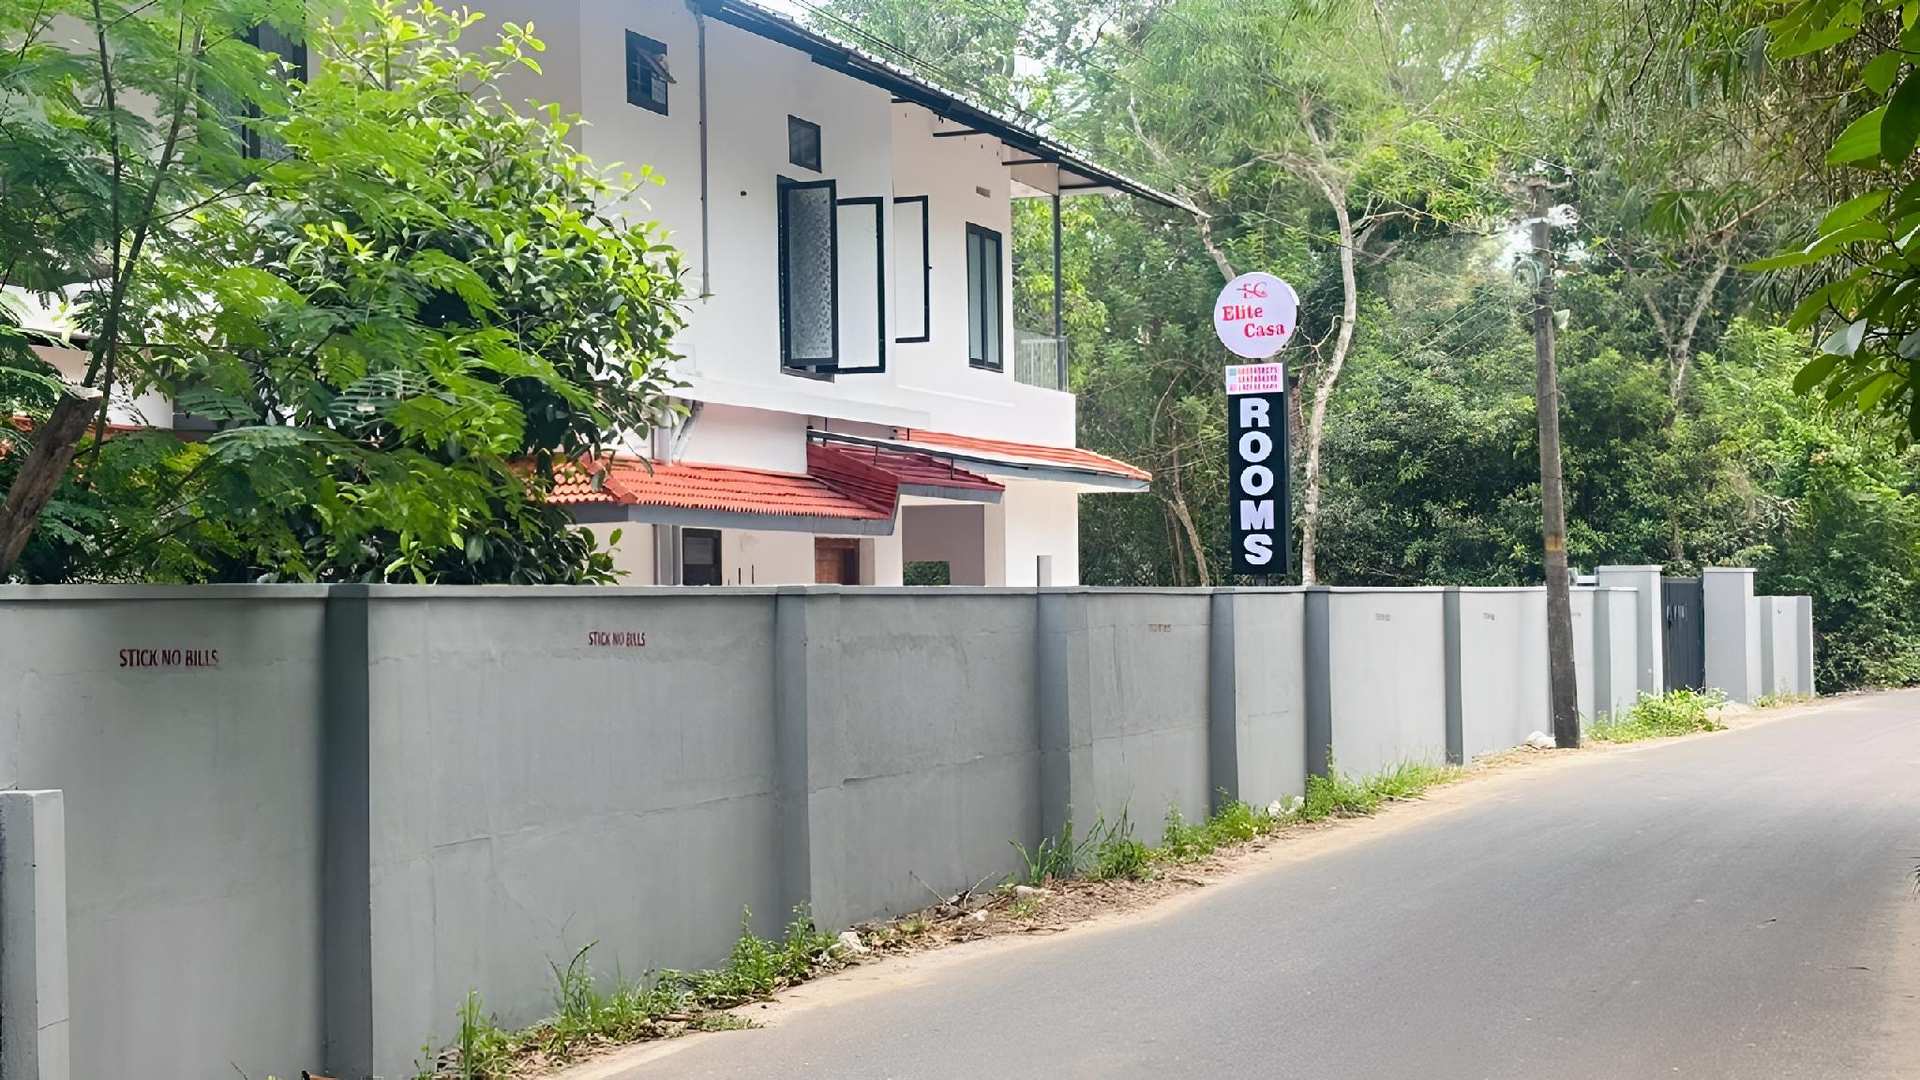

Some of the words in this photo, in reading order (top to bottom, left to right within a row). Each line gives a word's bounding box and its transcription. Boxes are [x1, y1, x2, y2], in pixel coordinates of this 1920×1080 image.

[1222, 304, 1263, 321] Elite
[1244, 323, 1285, 338] Casa
[1239, 397, 1274, 565] ROOMS
[589, 631, 610, 646] STICK
[613, 632, 624, 646] NO
[626, 632, 646, 647] BILLS
[119, 648, 158, 668] STICK
[161, 649, 181, 666] NO
[185, 649, 219, 667] BILLS
